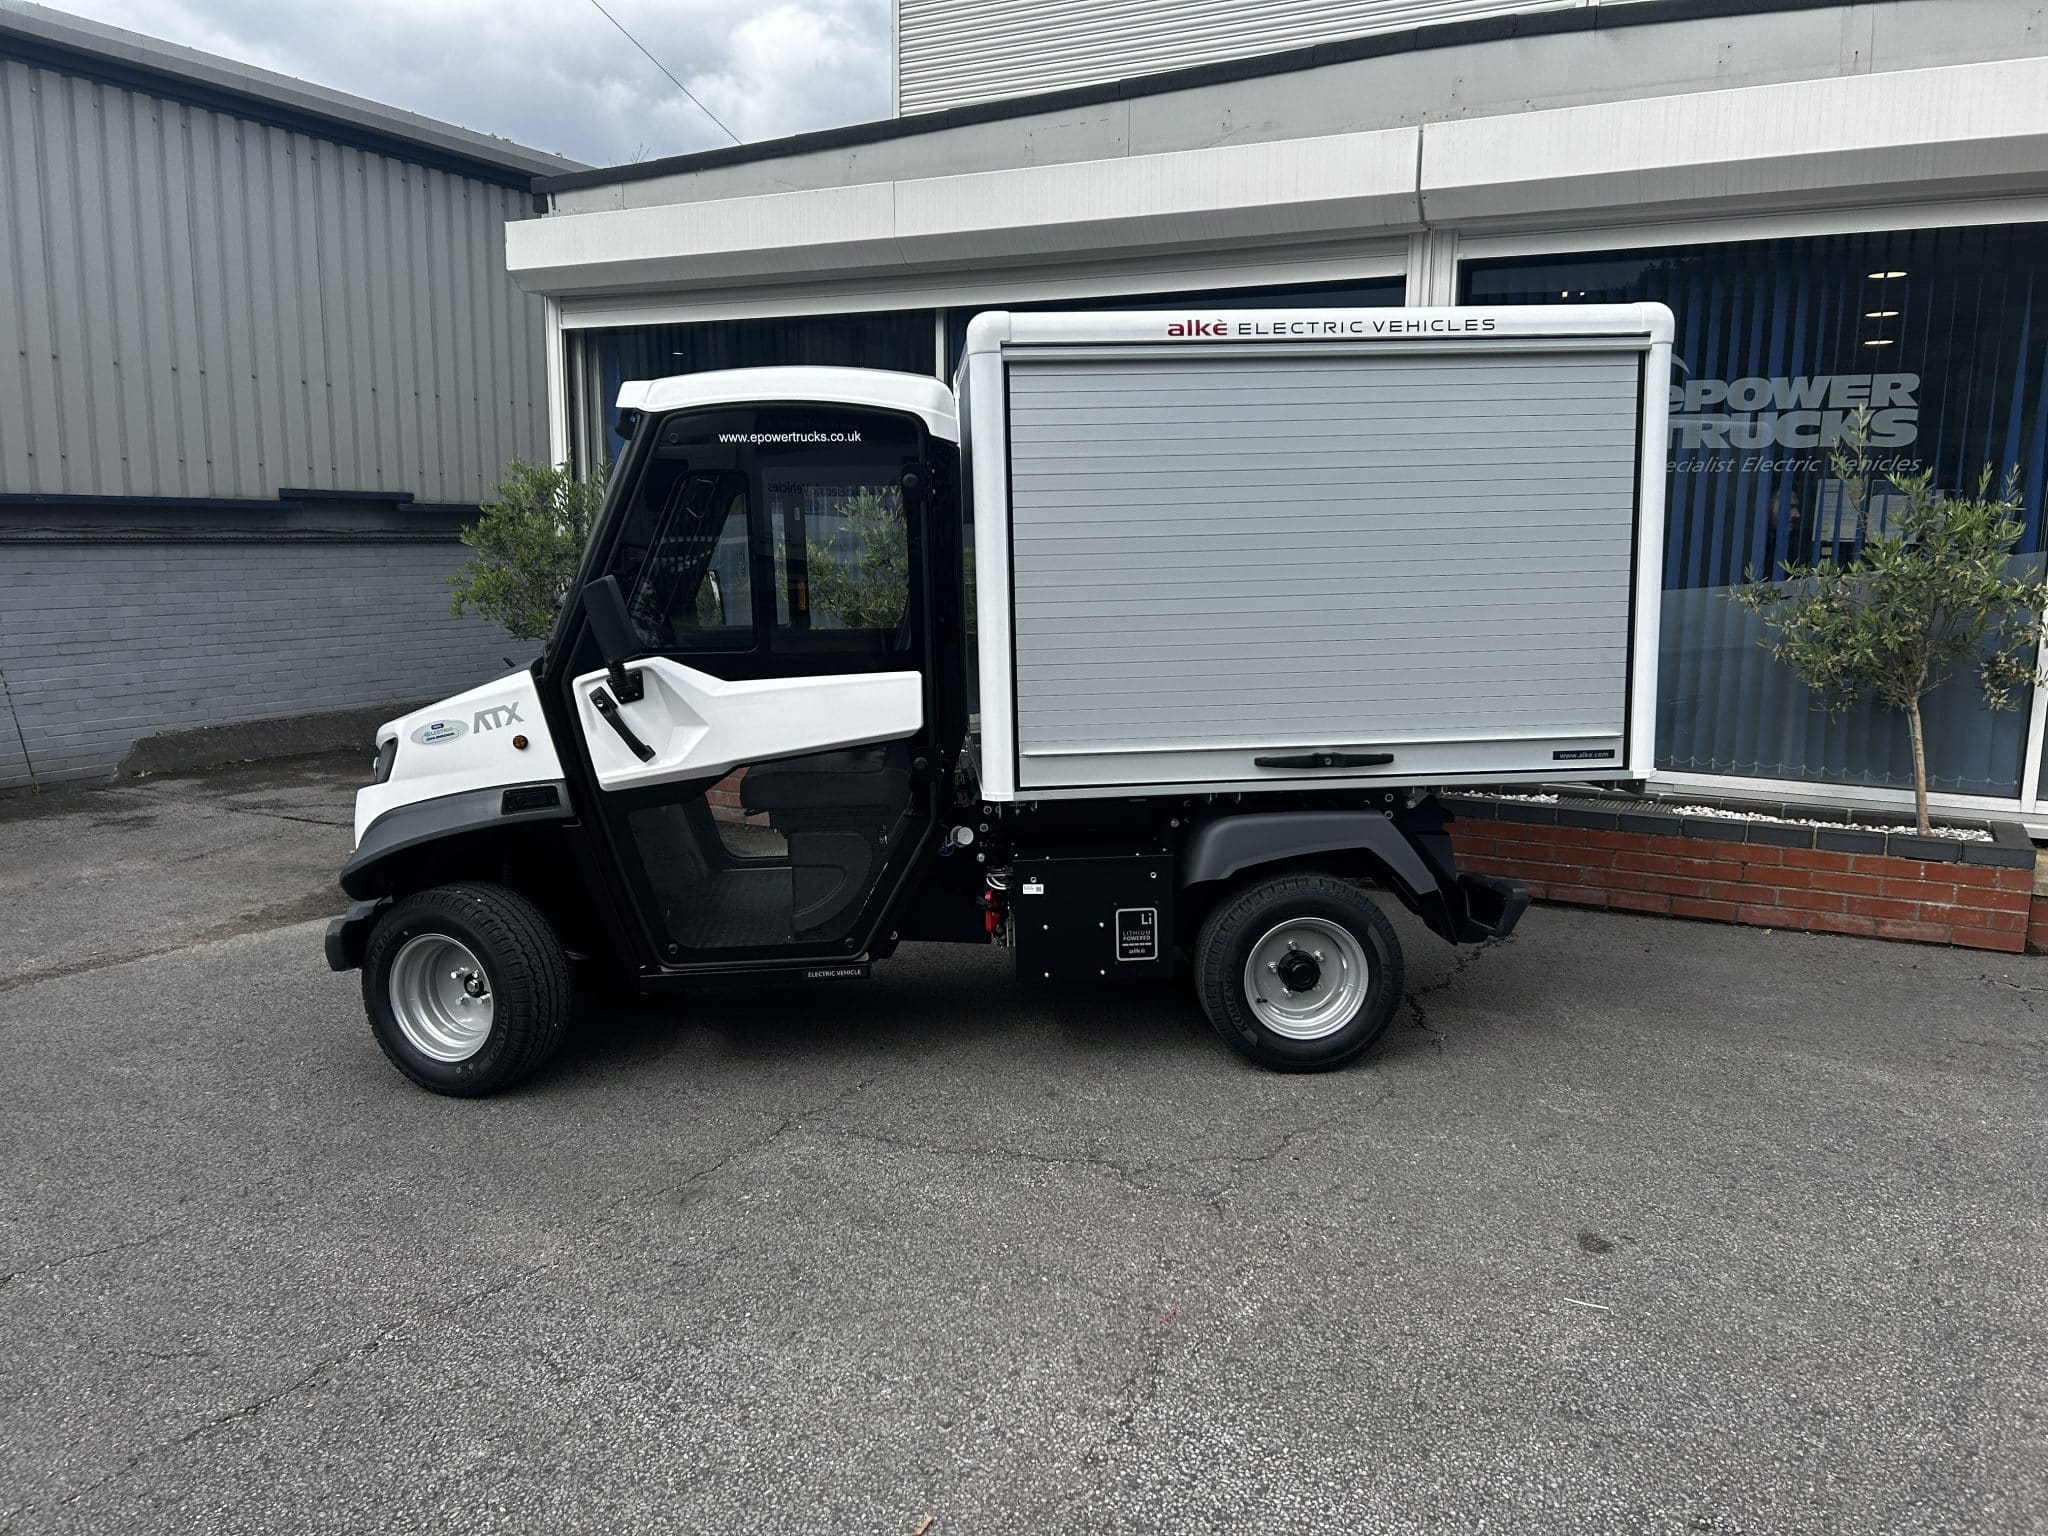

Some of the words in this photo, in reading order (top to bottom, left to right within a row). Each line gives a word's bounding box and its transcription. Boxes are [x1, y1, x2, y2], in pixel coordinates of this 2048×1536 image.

[1167, 318, 1228, 337] alkè
[1238, 320, 1364, 336] ELECTRIC
[1373, 317, 1497, 333] VEHICLES
[718, 430, 862, 445] www.epowertrucks.co.uk
[1666, 456, 1737, 473] ecialist
[1741, 455, 1822, 473] Electric
[1829, 454, 1923, 472] Vehicles
[473, 701, 526, 734] ATX
[1141, 912, 1152, 925] Li
[807, 970, 836, 978] ELECTRIC
[836, 968, 862, 976] VEHICLE
